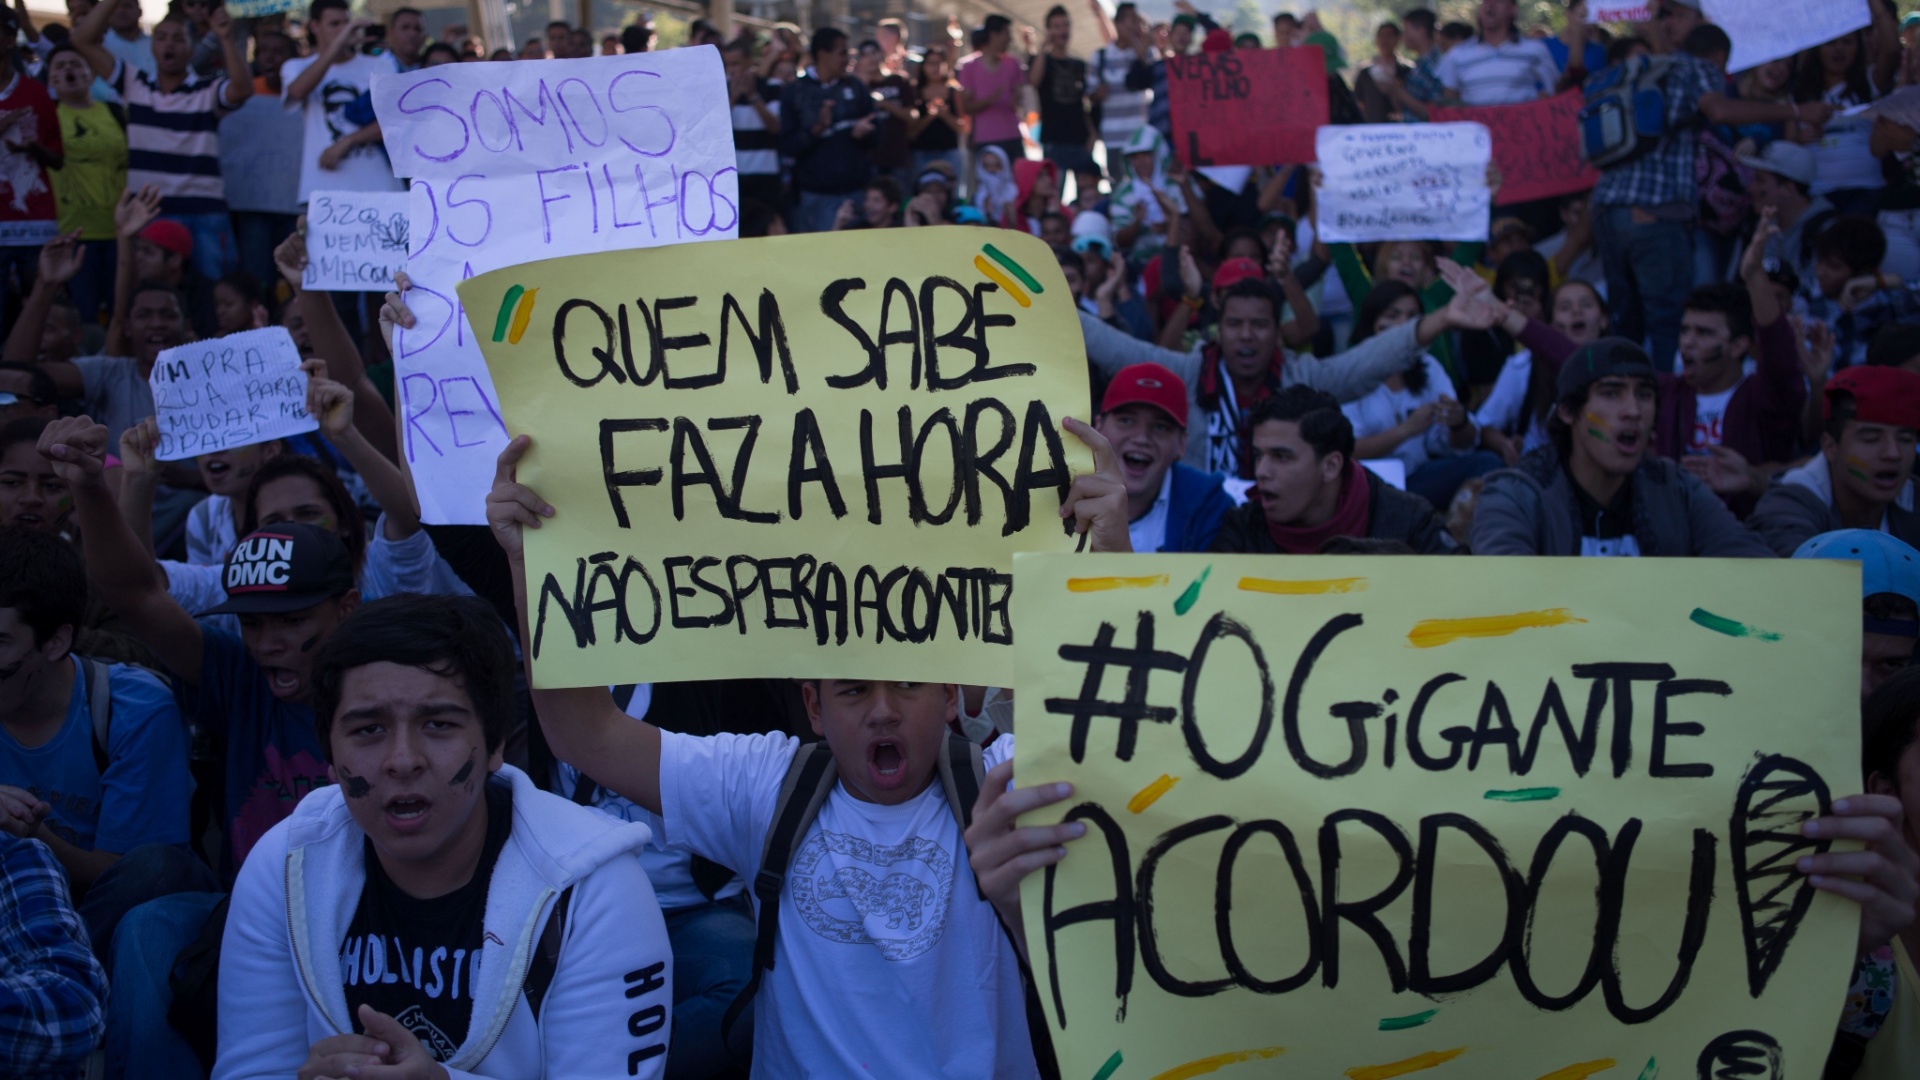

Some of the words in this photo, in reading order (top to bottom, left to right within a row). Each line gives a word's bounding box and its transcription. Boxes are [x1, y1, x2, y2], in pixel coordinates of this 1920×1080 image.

[398, 70, 677, 163] SOMOS
[324, 232, 377, 253] NEM
[202, 347, 265, 379] PRA
[552, 288, 800, 396] QUEM
[820, 276, 1036, 393] SABE
[157, 382, 228, 416] RUA
[244, 376, 304, 402] PARA
[169, 404, 269, 432] MUDAR
[599, 414, 782, 529] FAZ
[788, 407, 848, 521] A
[227, 560, 291, 589] DMC
[231, 537, 294, 564] RUN
[535, 552, 662, 660] NÃO
[664, 553, 848, 646] ESPERA
[1043, 609, 1274, 781] #O
[623, 961, 666, 1076] HOL
